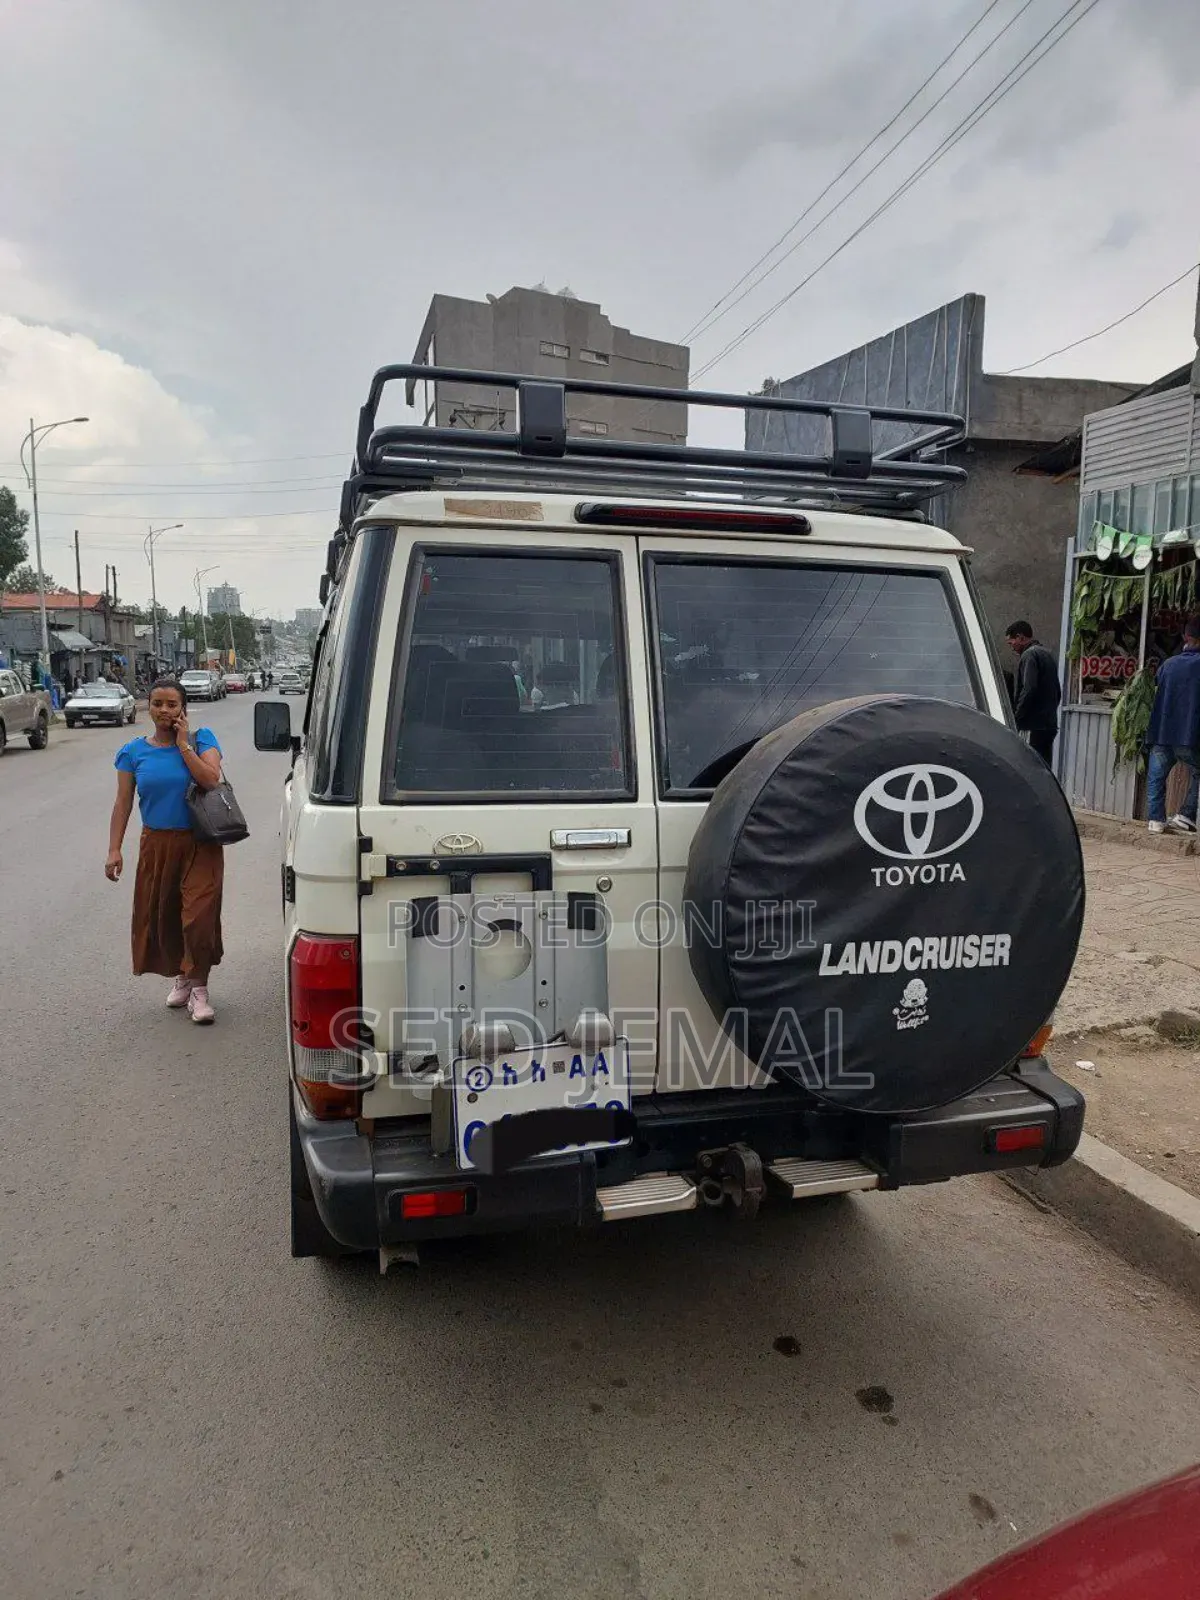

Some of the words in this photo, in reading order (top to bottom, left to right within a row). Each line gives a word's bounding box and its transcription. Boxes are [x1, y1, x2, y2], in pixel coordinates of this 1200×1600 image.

[871, 862, 966, 887] TOYOTA
[818, 933, 1012, 976] LANDCRUISER
[569, 1052, 609, 1080] AA
